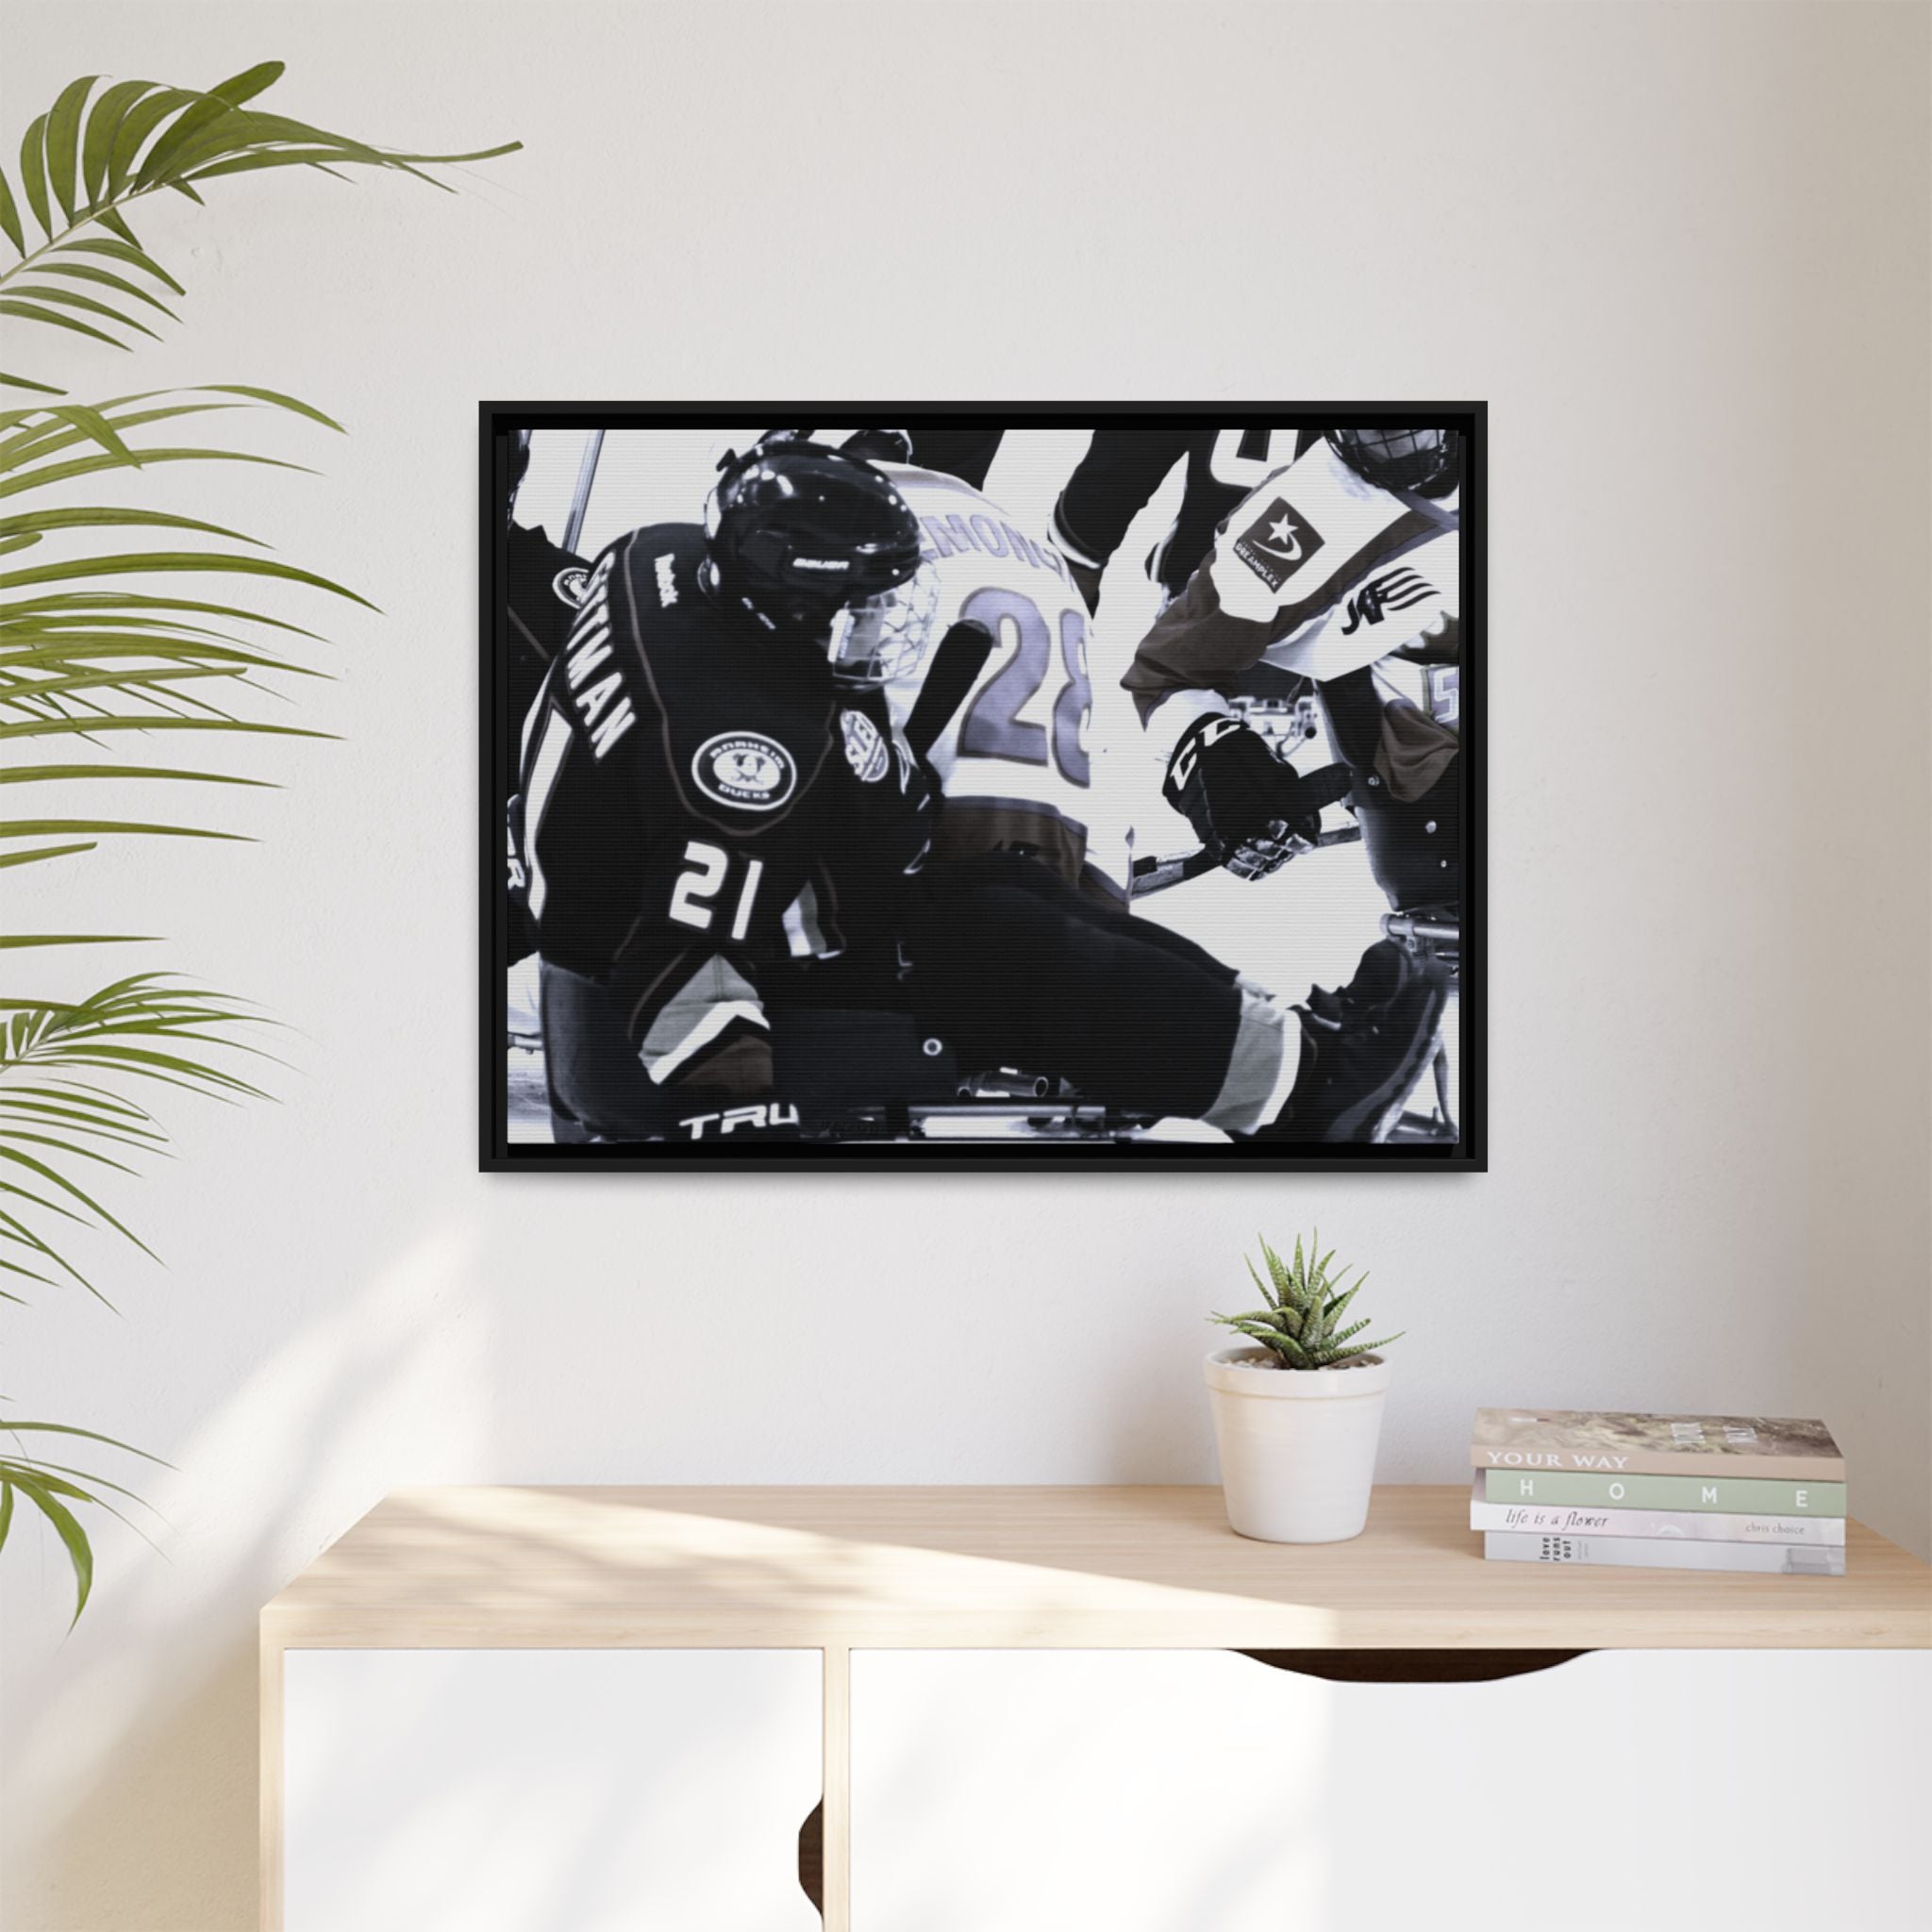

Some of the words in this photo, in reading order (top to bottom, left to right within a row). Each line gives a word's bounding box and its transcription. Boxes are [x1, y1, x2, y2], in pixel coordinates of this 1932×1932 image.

[957, 586, 1092, 790] 28
[718, 783, 771, 799] DUCKS
[669, 841, 763, 940] 21
[1487, 1451, 1563, 1467] YOUR
[1573, 1455, 1629, 1469] WAY
[1506, 1508, 1528, 1528] life
[1534, 1511, 1546, 1525] is
[1551, 1515, 1559, 1525] a
[1562, 1510, 1609, 1531] flower
[1745, 1522, 1770, 1534] chris
[1773, 1524, 1805, 1536] choice
[1539, 1537, 1550, 1560] love
[1553, 1537, 1561, 1561] runs
[1562, 1540, 1572, 1558] out
